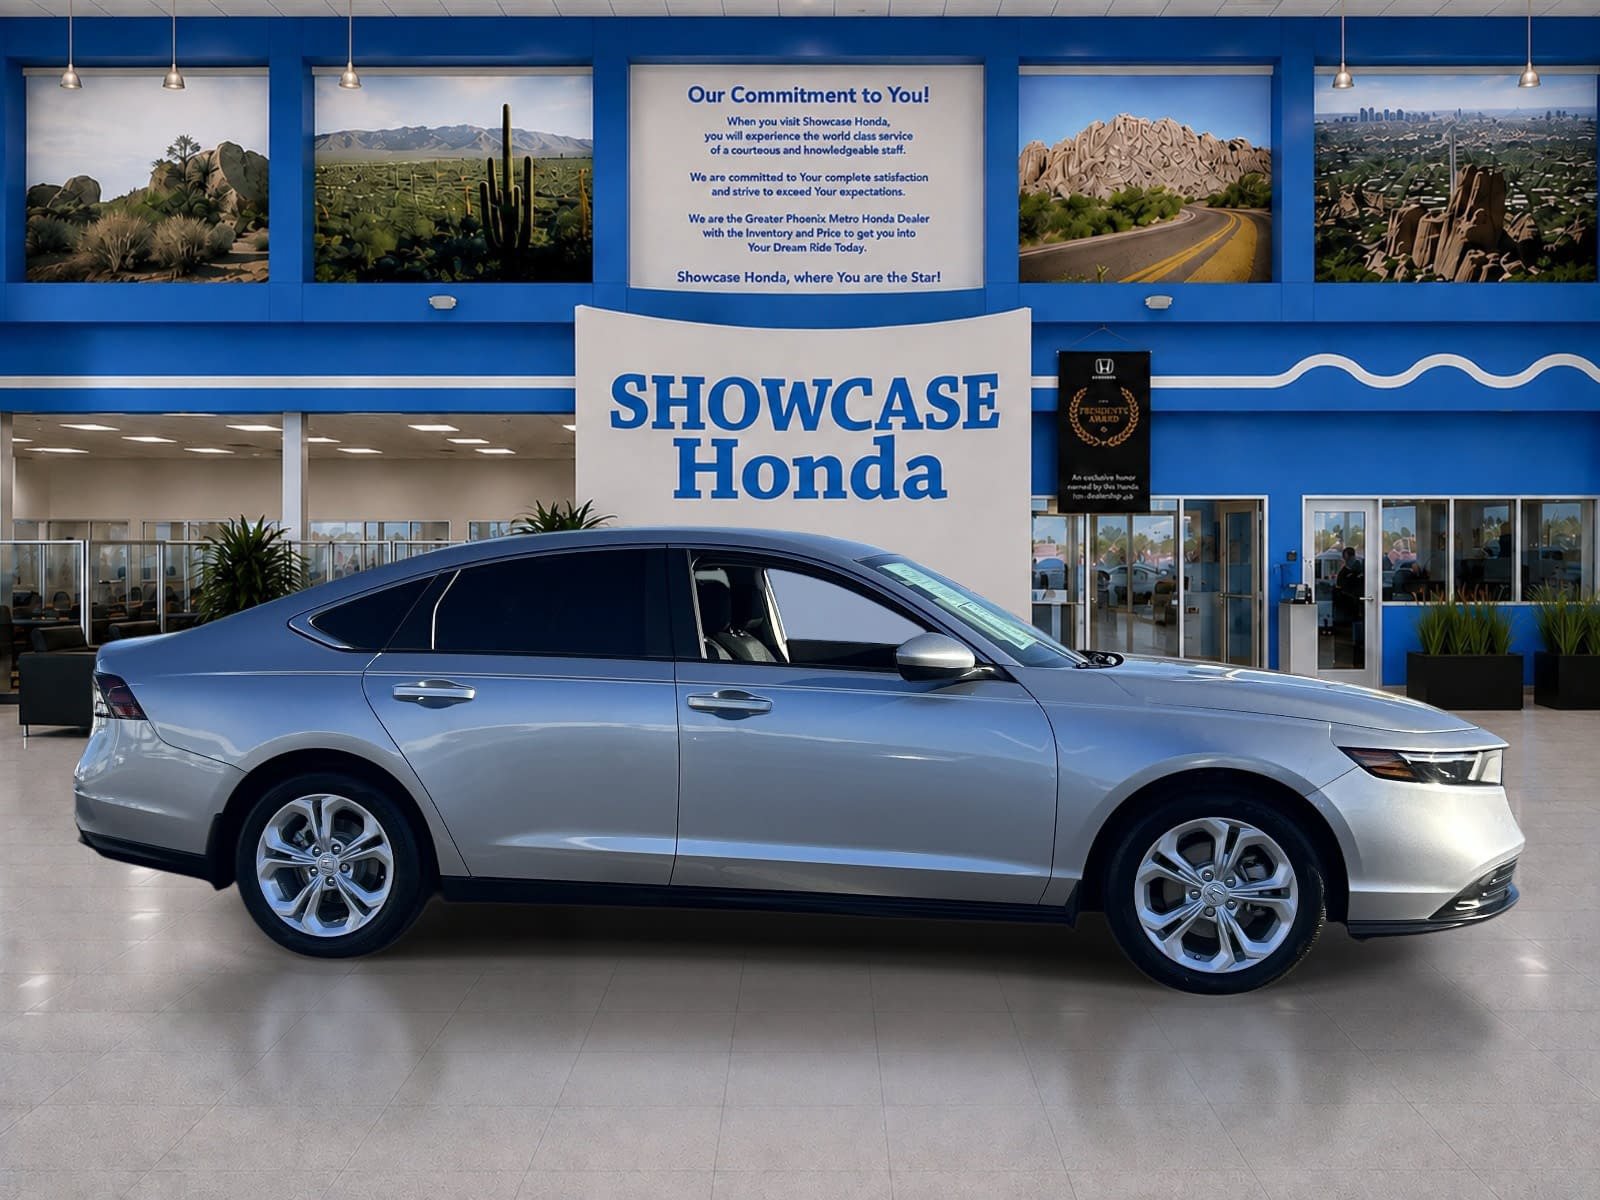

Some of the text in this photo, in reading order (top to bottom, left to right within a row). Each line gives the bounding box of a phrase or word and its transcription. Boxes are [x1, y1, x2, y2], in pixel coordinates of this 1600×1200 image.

[687, 85, 930, 104] Our Commitment to You!
[726, 115, 891, 129] When you visit Showcase Honda,
[704, 130, 914, 144] you will experience the world class service
[709, 144, 722, 155] of
[722, 147, 730, 156] a
[730, 146, 782, 156] courteous
[782, 144, 802, 156] and
[881, 143, 907, 156] staff.
[689, 171, 929, 185] We are committed to Your complete satisfaction
[711, 185, 906, 200] and strive to exceed Your expectations.
[687, 212, 931, 225] We are the Greater Phoenix Metro Honda Dealer
[702, 227, 917, 241] with the Inventory and Price to get you into
[747, 241, 868, 255] Your Dream Ride Today.
[676, 270, 941, 286] Showcase Honda, where You are the Star!
[610, 373, 1000, 431] SHOWCASE
[672, 434, 948, 501] Honda
